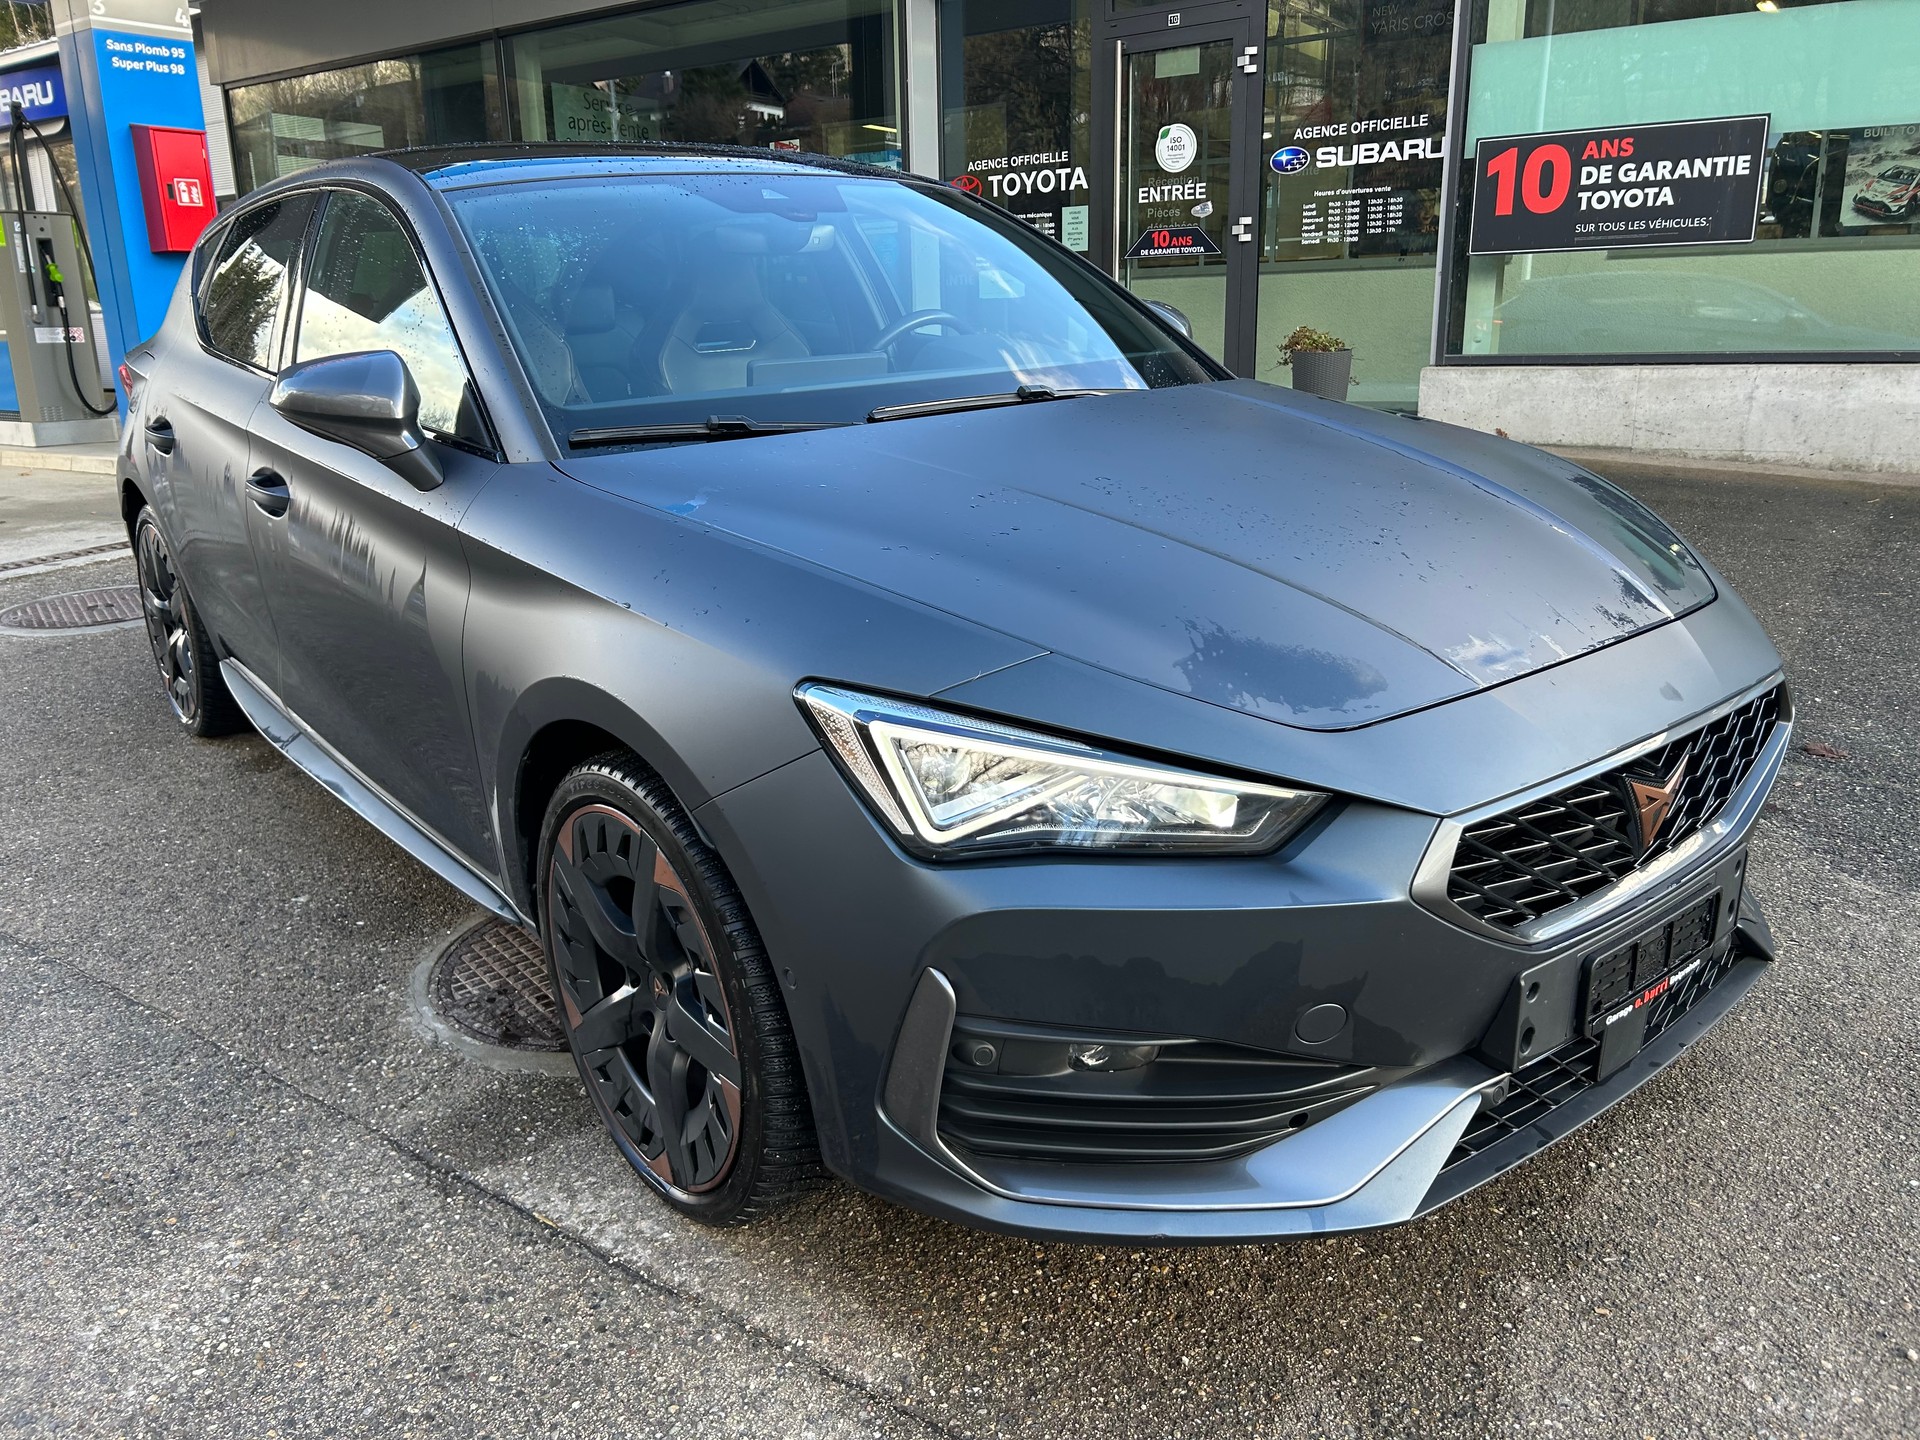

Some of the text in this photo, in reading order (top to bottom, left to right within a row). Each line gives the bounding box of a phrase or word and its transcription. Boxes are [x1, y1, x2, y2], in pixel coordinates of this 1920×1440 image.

[174, 8, 189, 27] 4
[1372, 4, 1399, 17] NEW
[1371, 17, 1409, 35] YARIS
[106, 39, 186, 59] Sans Plomb 95
[112, 56, 185, 76] Super Plus 98
[583, 92, 633, 115] Serce
[568, 115, 649, 140] après-ente
[1294, 114, 1429, 140] AGENCE OFFICIELLE
[1863, 126, 1898, 138] BUILT
[1899, 125, 1916, 135] TO
[1166, 144, 1185, 152] 14001
[1170, 136, 1182, 144] ISO
[1581, 137, 1634, 160] ANS
[967, 151, 1069, 172] AGENCE OFFICIELLE
[1315, 136, 1445, 168] SUBARU
[1486, 143, 1572, 216] 10
[1580, 154, 1752, 186] DE GARANTIE
[988, 166, 1089, 197] TOYOTA
[1138, 179, 1206, 203] ENTRÉE
[1374, 185, 1391, 193] vente
[1577, 186, 1674, 211] TOYOTA
[1147, 207, 1180, 218] Pièces
[1575, 223, 1595, 233] SUR
[1598, 221, 1626, 232] TOUS
[1628, 220, 1645, 230] LES
[1152, 230, 1192, 247] 10 ANS
[1150, 247, 1180, 255] GARANTIE
[1606, 1004, 1634, 1025] Garage
